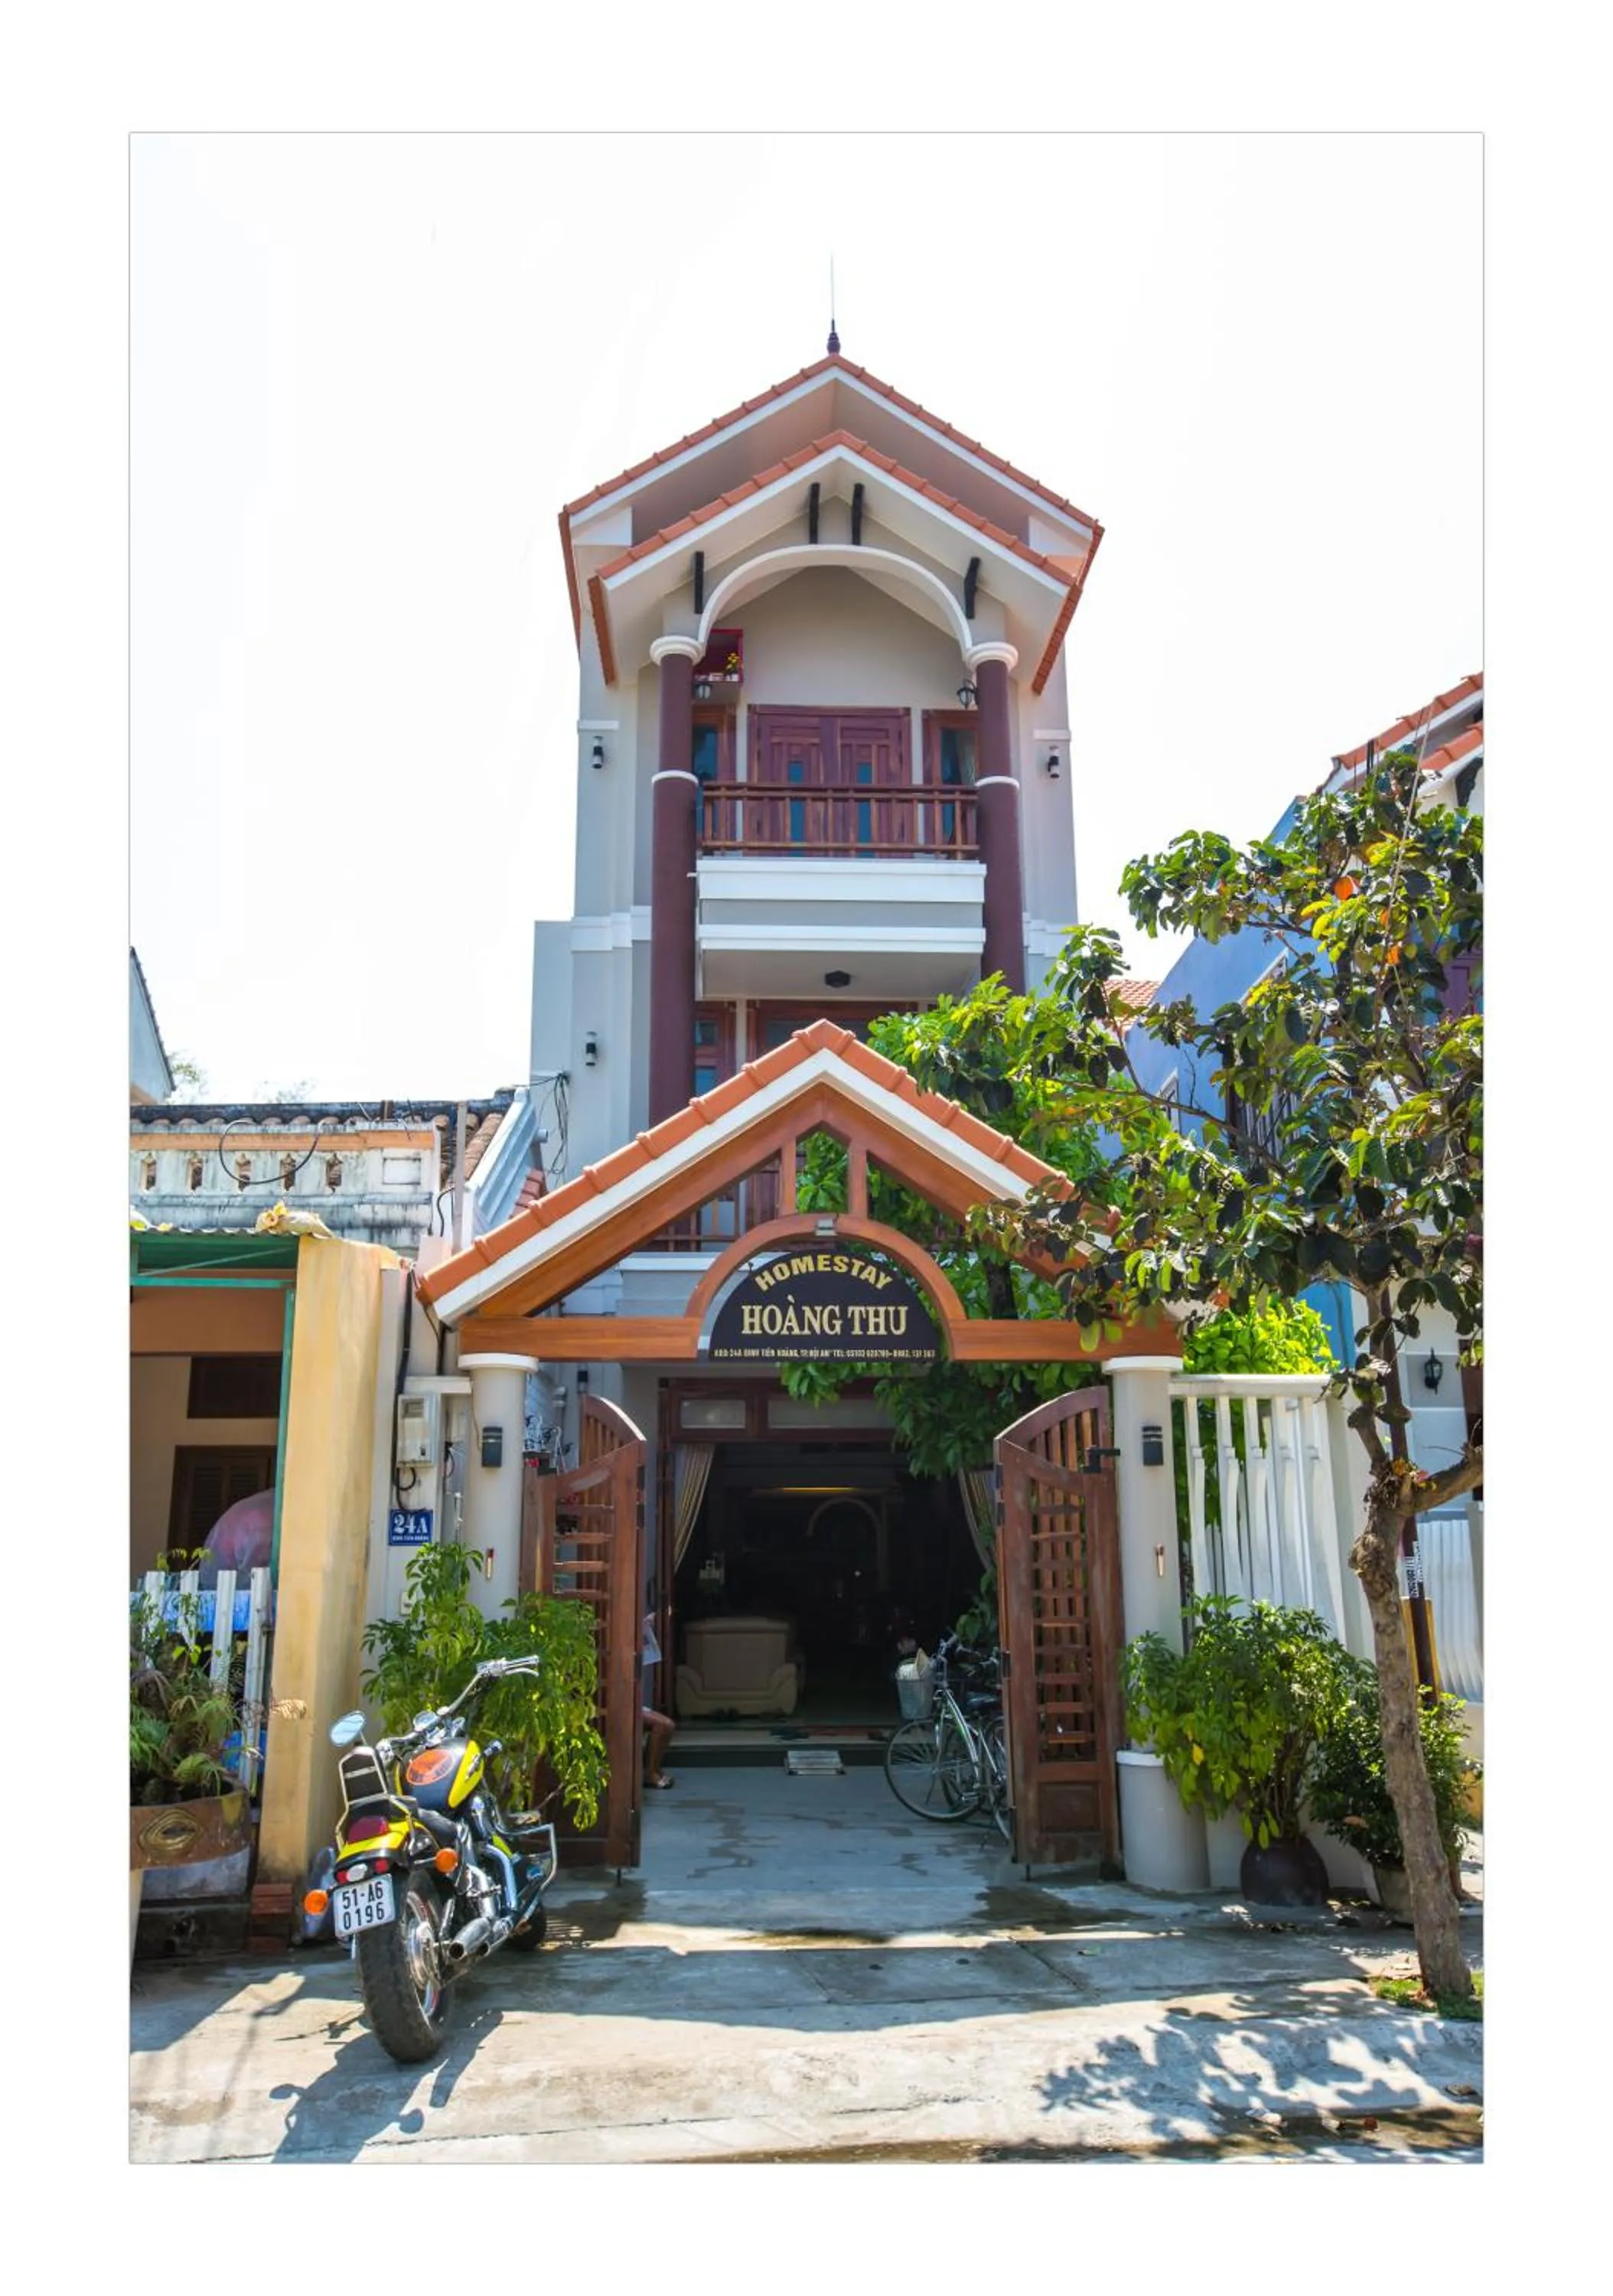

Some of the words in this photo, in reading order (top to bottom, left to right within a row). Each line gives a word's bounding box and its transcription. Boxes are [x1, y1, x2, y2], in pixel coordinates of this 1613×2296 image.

[754, 1254, 894, 1292] HOMESTAY
[741, 1294, 842, 1336] HOÀNG
[847, 1306, 909, 1336] THU
[394, 1515, 428, 1534] 24A
[342, 1880, 384, 1910] 51-A6
[343, 1902, 385, 1930] 0196
